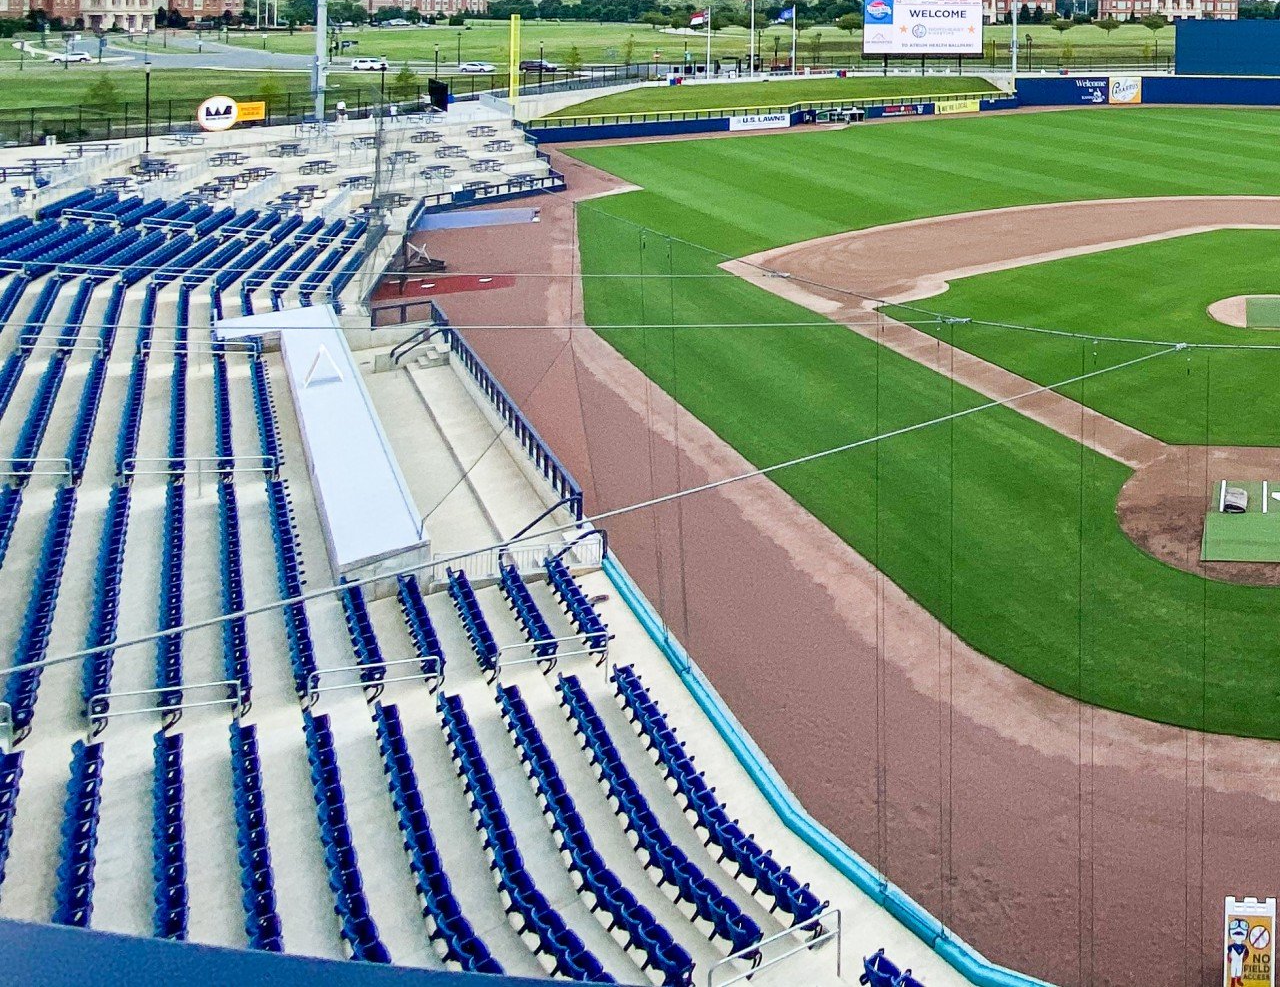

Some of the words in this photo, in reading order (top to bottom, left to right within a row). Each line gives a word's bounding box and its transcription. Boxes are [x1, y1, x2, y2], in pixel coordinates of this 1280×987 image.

[909, 9, 967, 19] WELCOME
[1253, 954, 1270, 963] NO
[1244, 964, 1270, 973] FIELD
